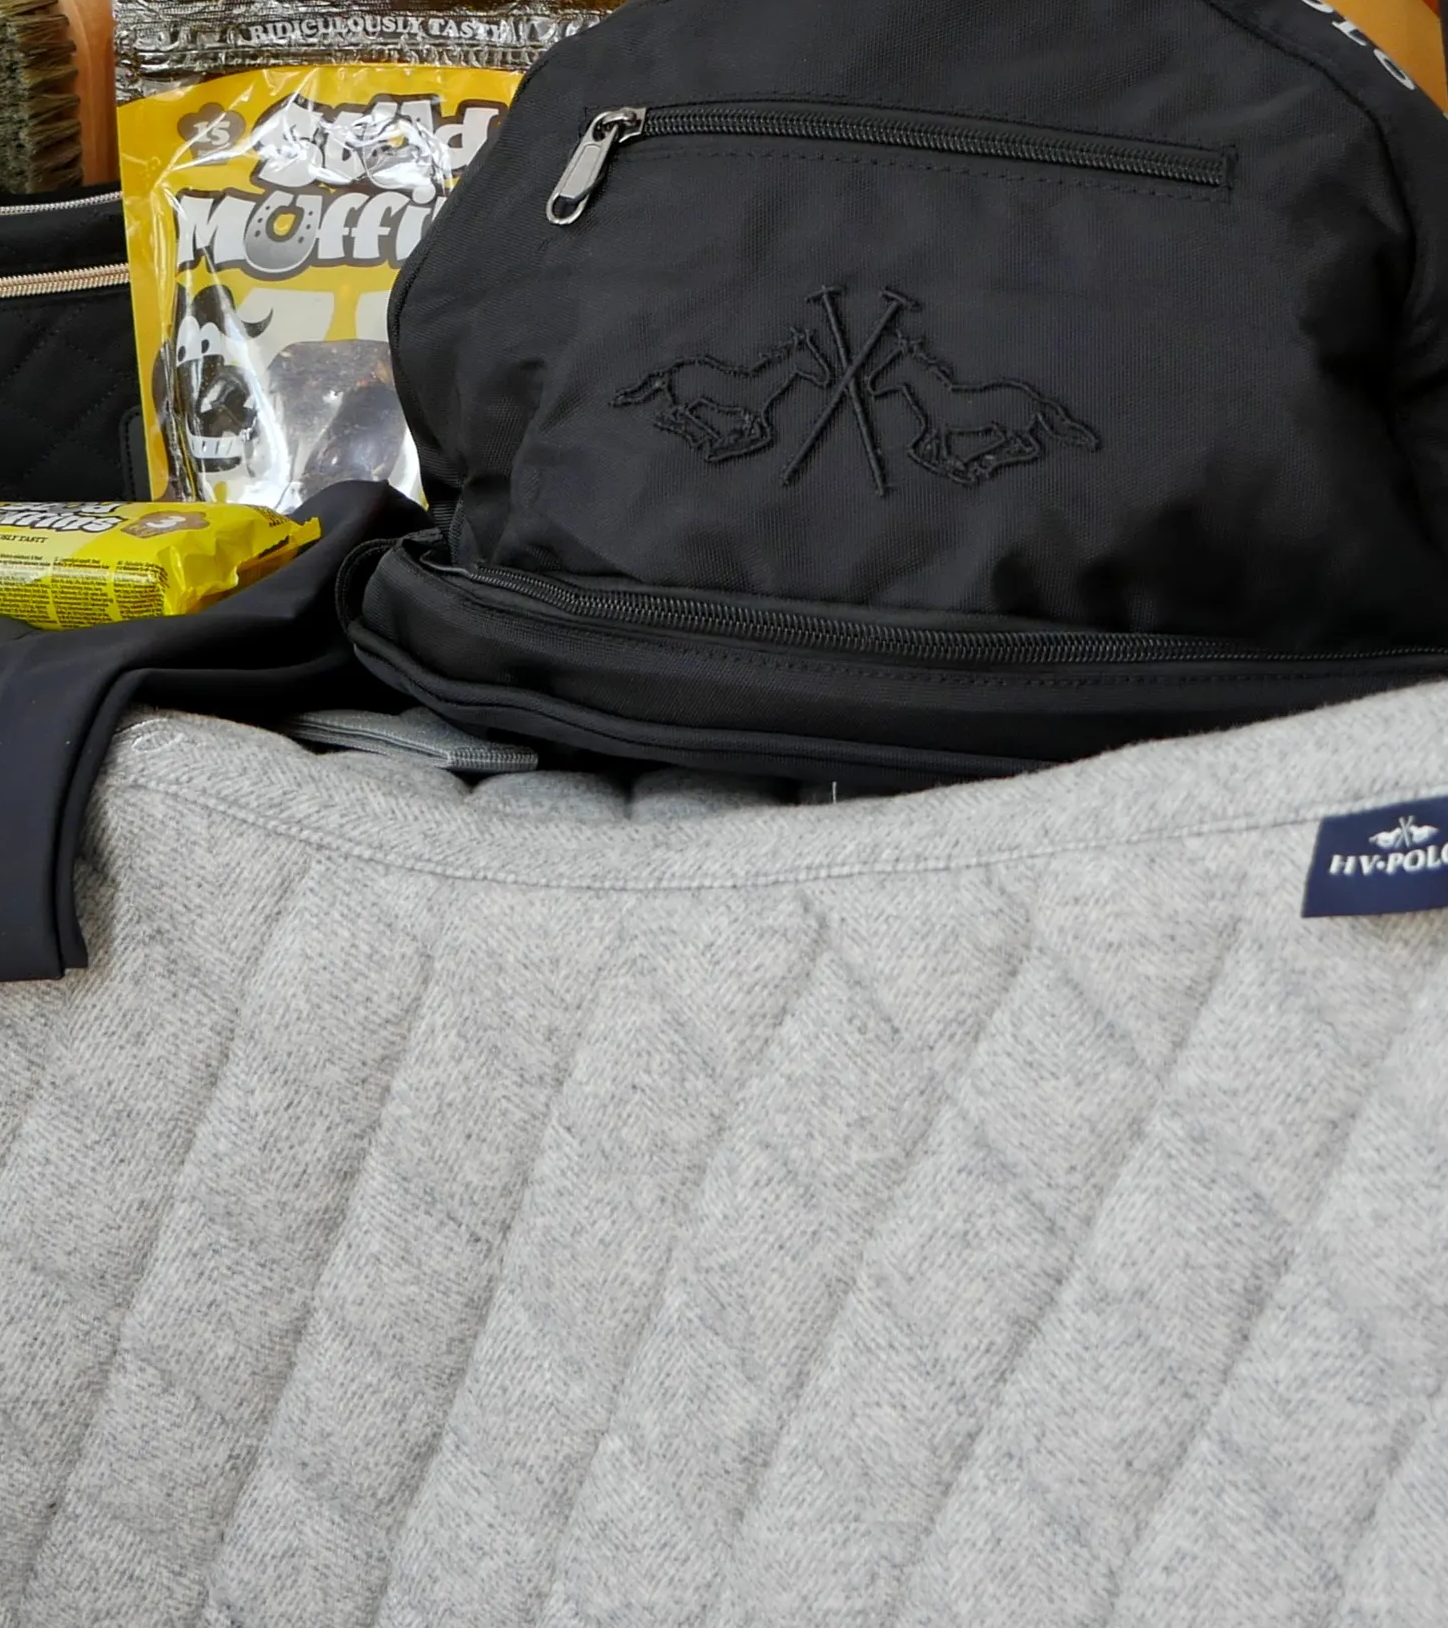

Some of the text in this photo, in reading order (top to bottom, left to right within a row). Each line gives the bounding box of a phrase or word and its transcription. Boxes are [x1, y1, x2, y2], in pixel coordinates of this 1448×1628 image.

[249, 15, 512, 45] RIDICULOUSLY TASTY
[176, 183, 449, 272] Muffi
